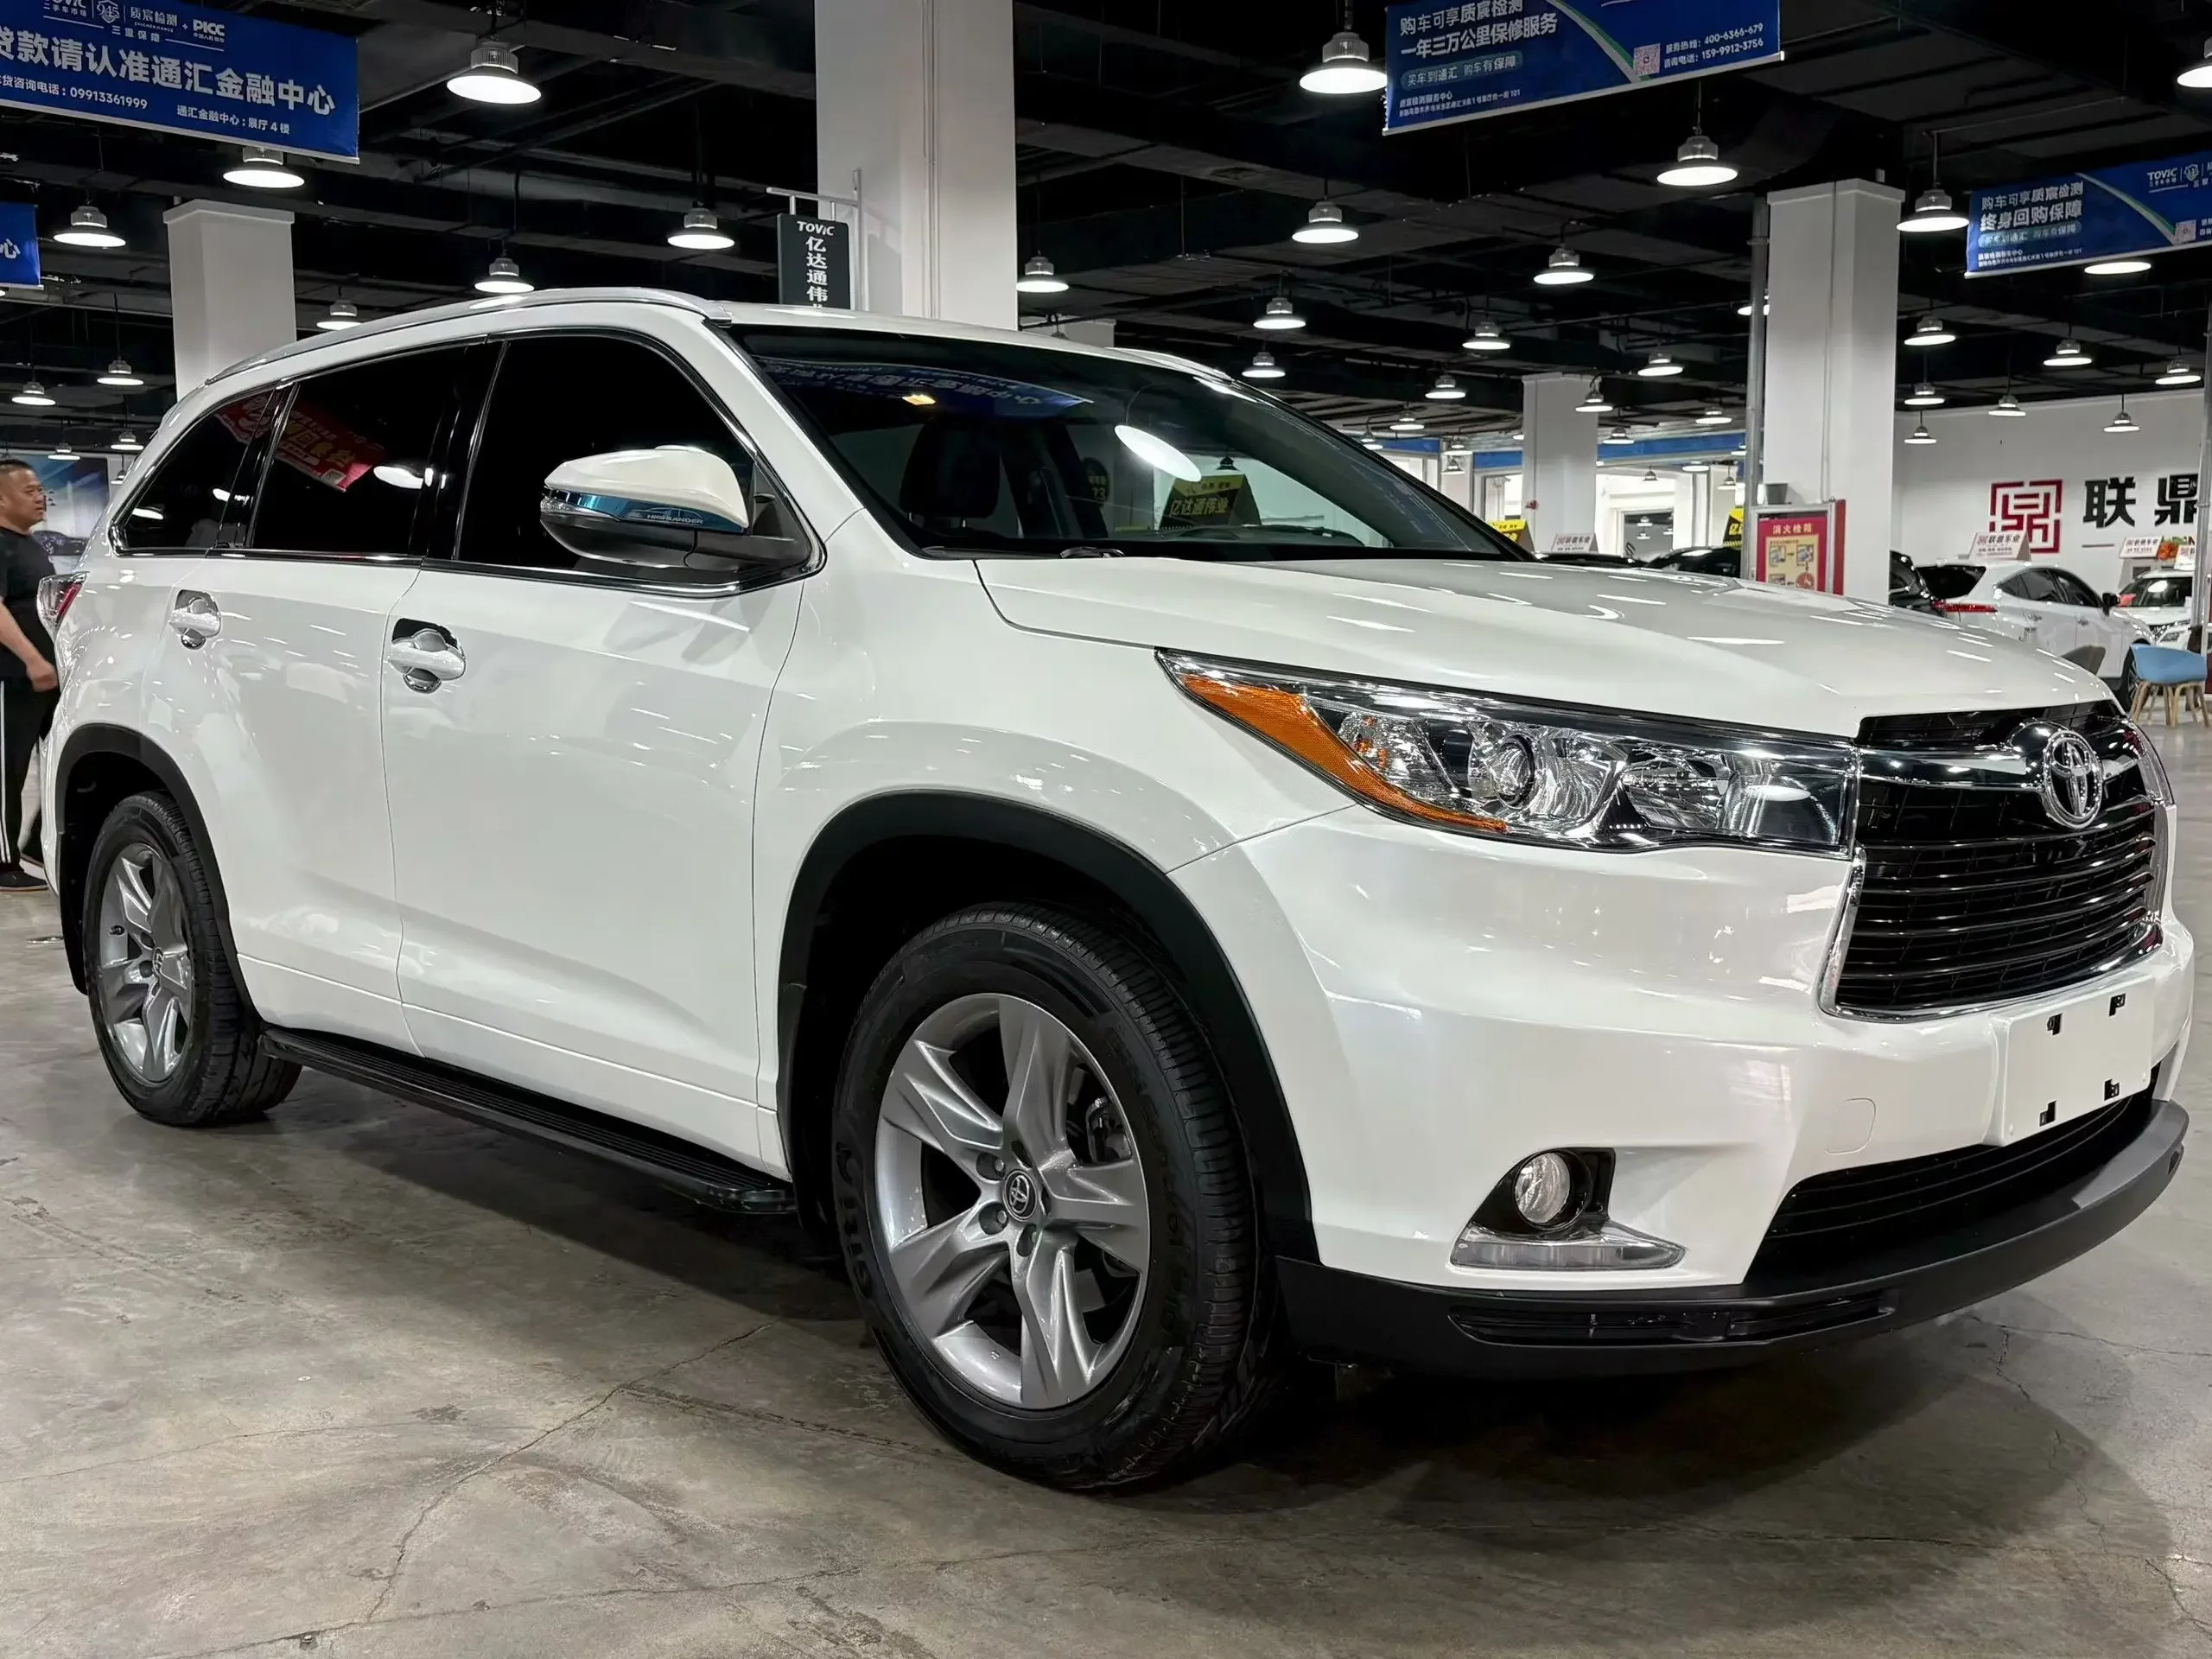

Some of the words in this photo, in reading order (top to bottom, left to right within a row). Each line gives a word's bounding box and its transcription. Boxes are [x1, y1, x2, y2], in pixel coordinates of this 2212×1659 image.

[193, 18, 226, 37] PICC
[1400, 12, 1558, 59] 一年三万公里保修服务
[0, 74, 148, 110] 贷咨询电话：09913361999
[2146, 167, 2177, 181] TOVIC
[797, 220, 836, 236] TOVIC
[1980, 199, 2082, 232] 终身回购保障
[804, 235, 829, 308] 亿达通伟
[2082, 474, 2198, 529] 联鼎
